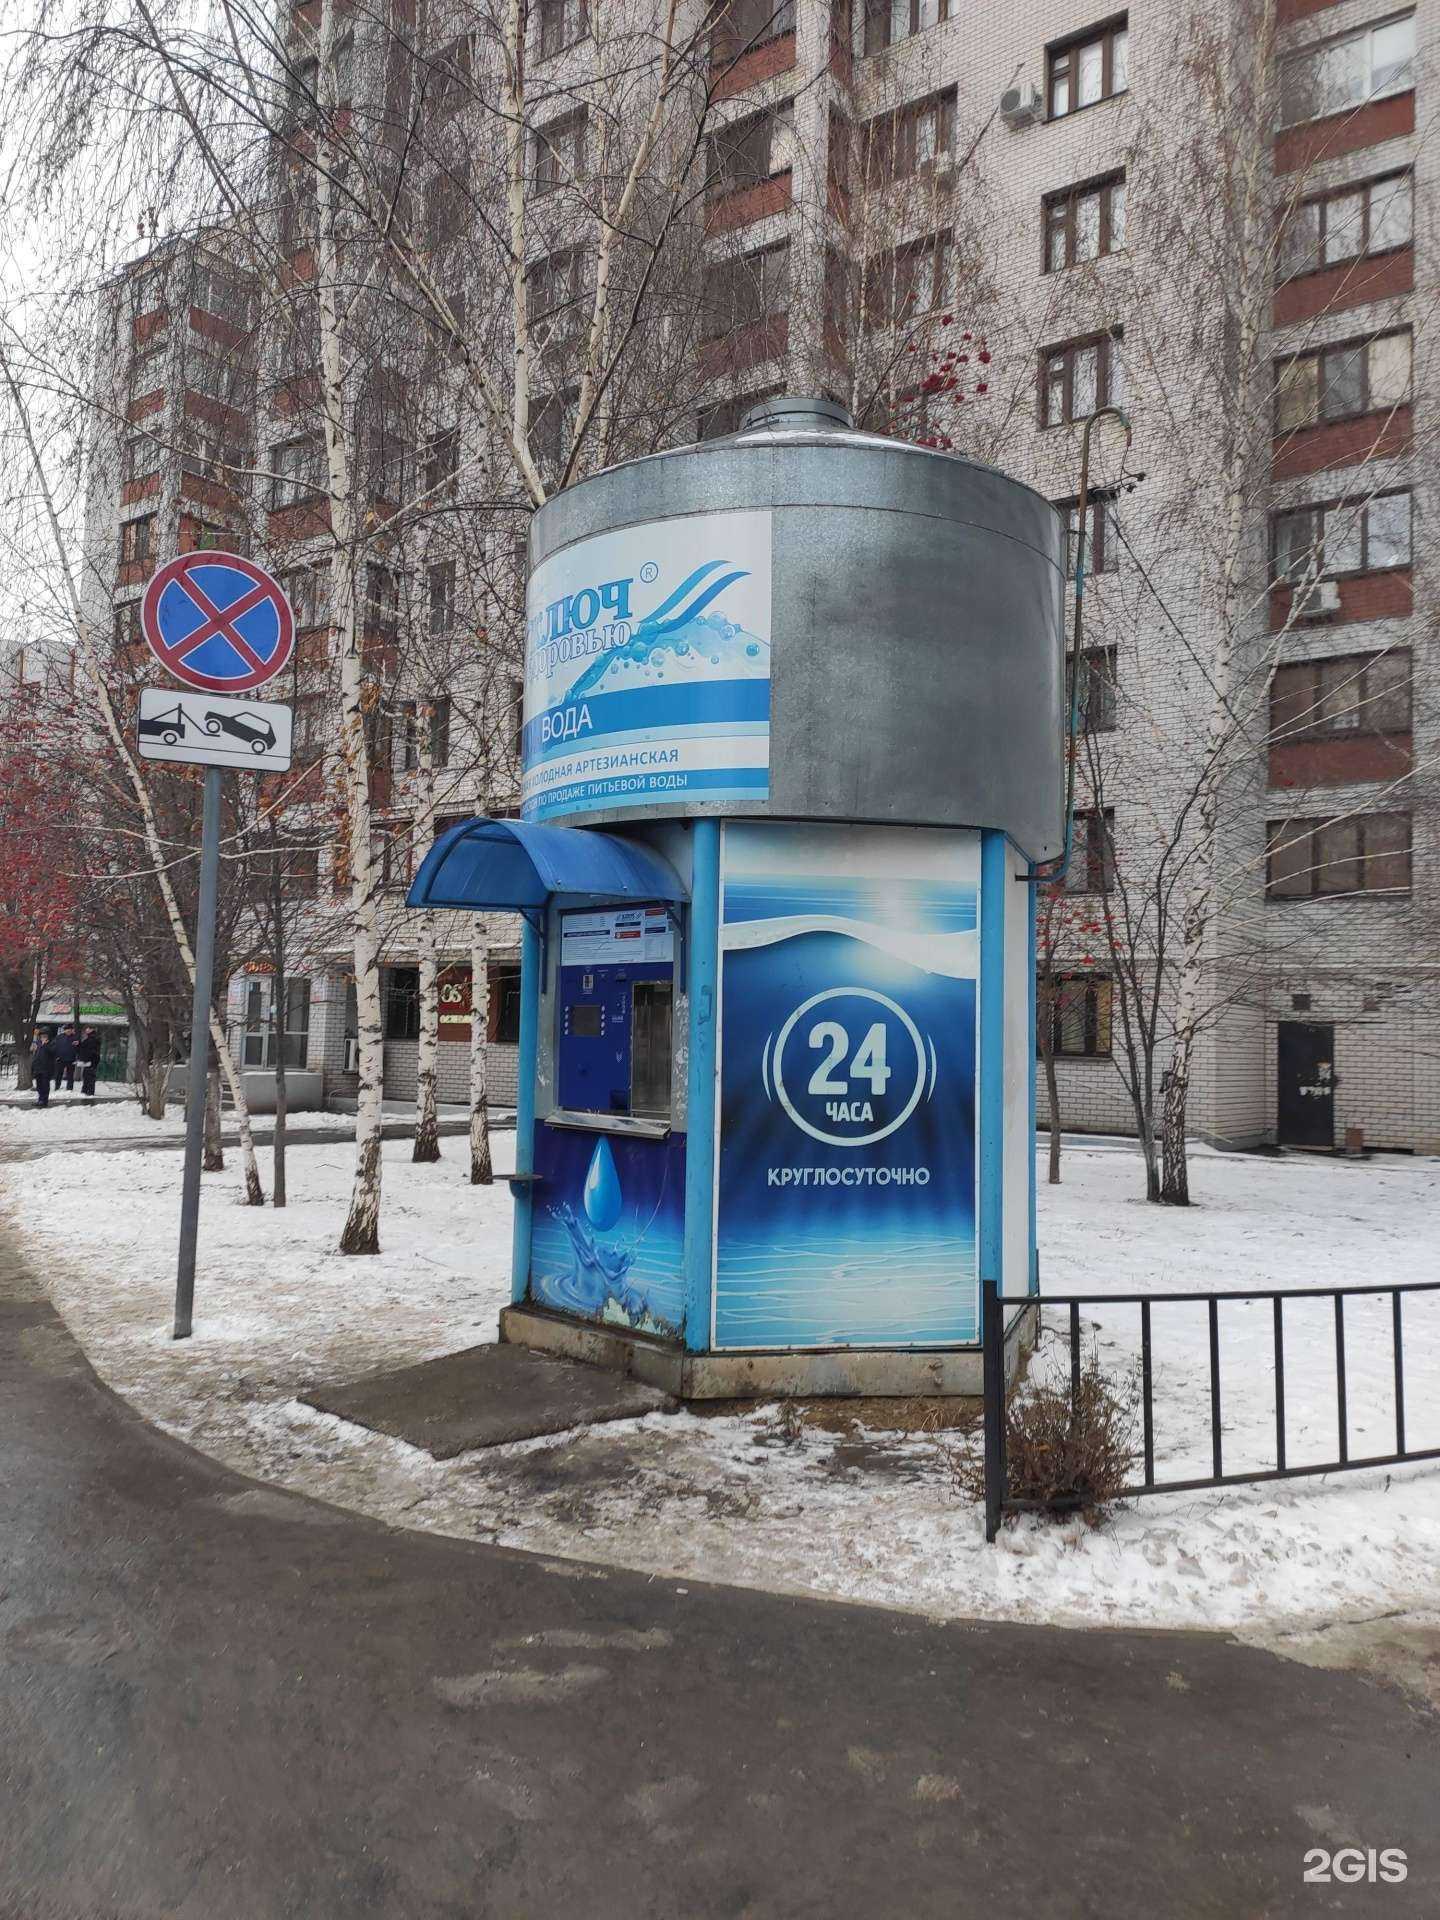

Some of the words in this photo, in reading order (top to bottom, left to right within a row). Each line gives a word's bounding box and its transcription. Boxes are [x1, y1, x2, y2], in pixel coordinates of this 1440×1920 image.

[542, 704, 593, 741] ВОДА
[575, 749, 679, 775] АРТЕЗИАНСКАЯ
[549, 785, 585, 805] ПРОДАЖЕ
[587, 775, 645, 796] ПИТЬЕВОЙ
[650, 774, 688, 789] ВОДЫ
[808, 1021, 891, 1095] 24
[825, 1101, 874, 1122] ЧАСА
[767, 1166, 931, 1186] КРУГЛОСУТОЧНО
